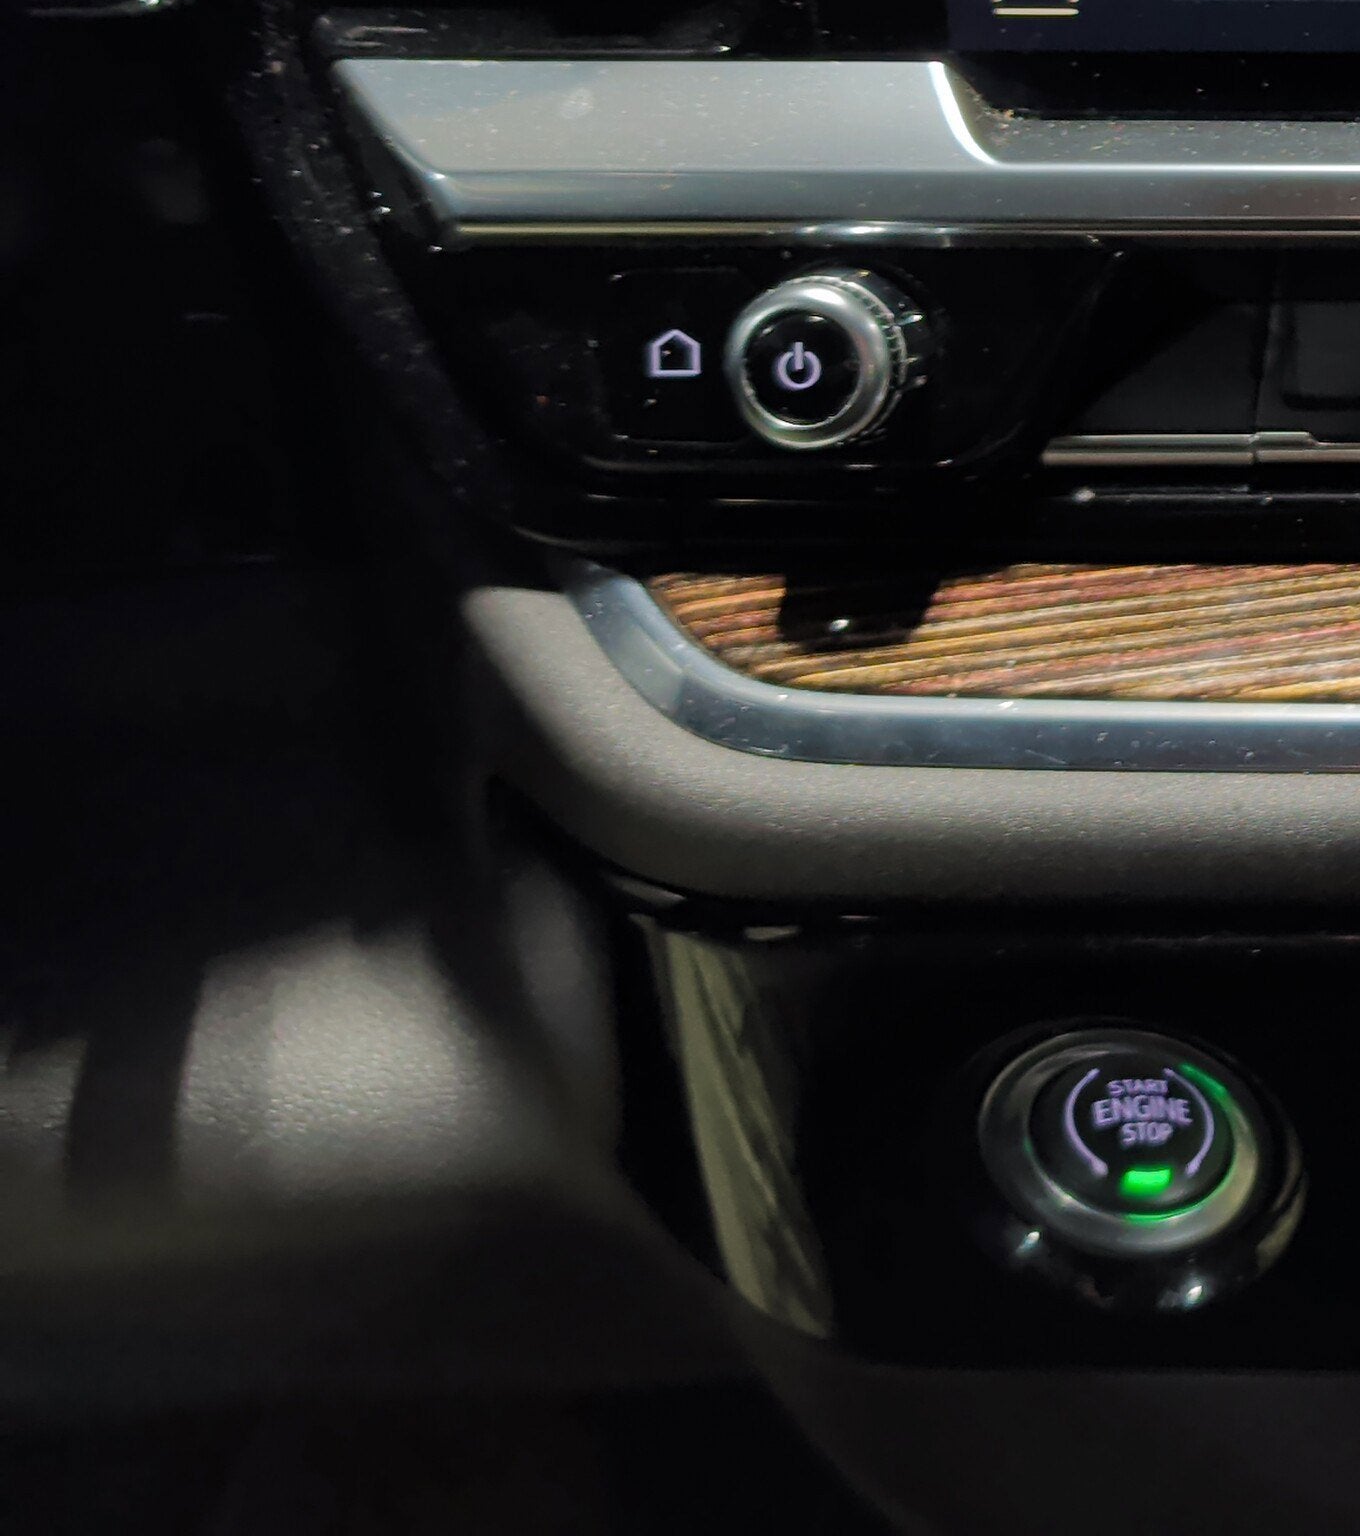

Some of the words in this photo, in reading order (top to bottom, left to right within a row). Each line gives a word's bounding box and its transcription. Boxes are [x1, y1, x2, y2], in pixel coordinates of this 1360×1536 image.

[1105, 1078, 1169, 1099] START
[1092, 1095, 1193, 1130] ENGINE
[1120, 1121, 1174, 1148] STOP
